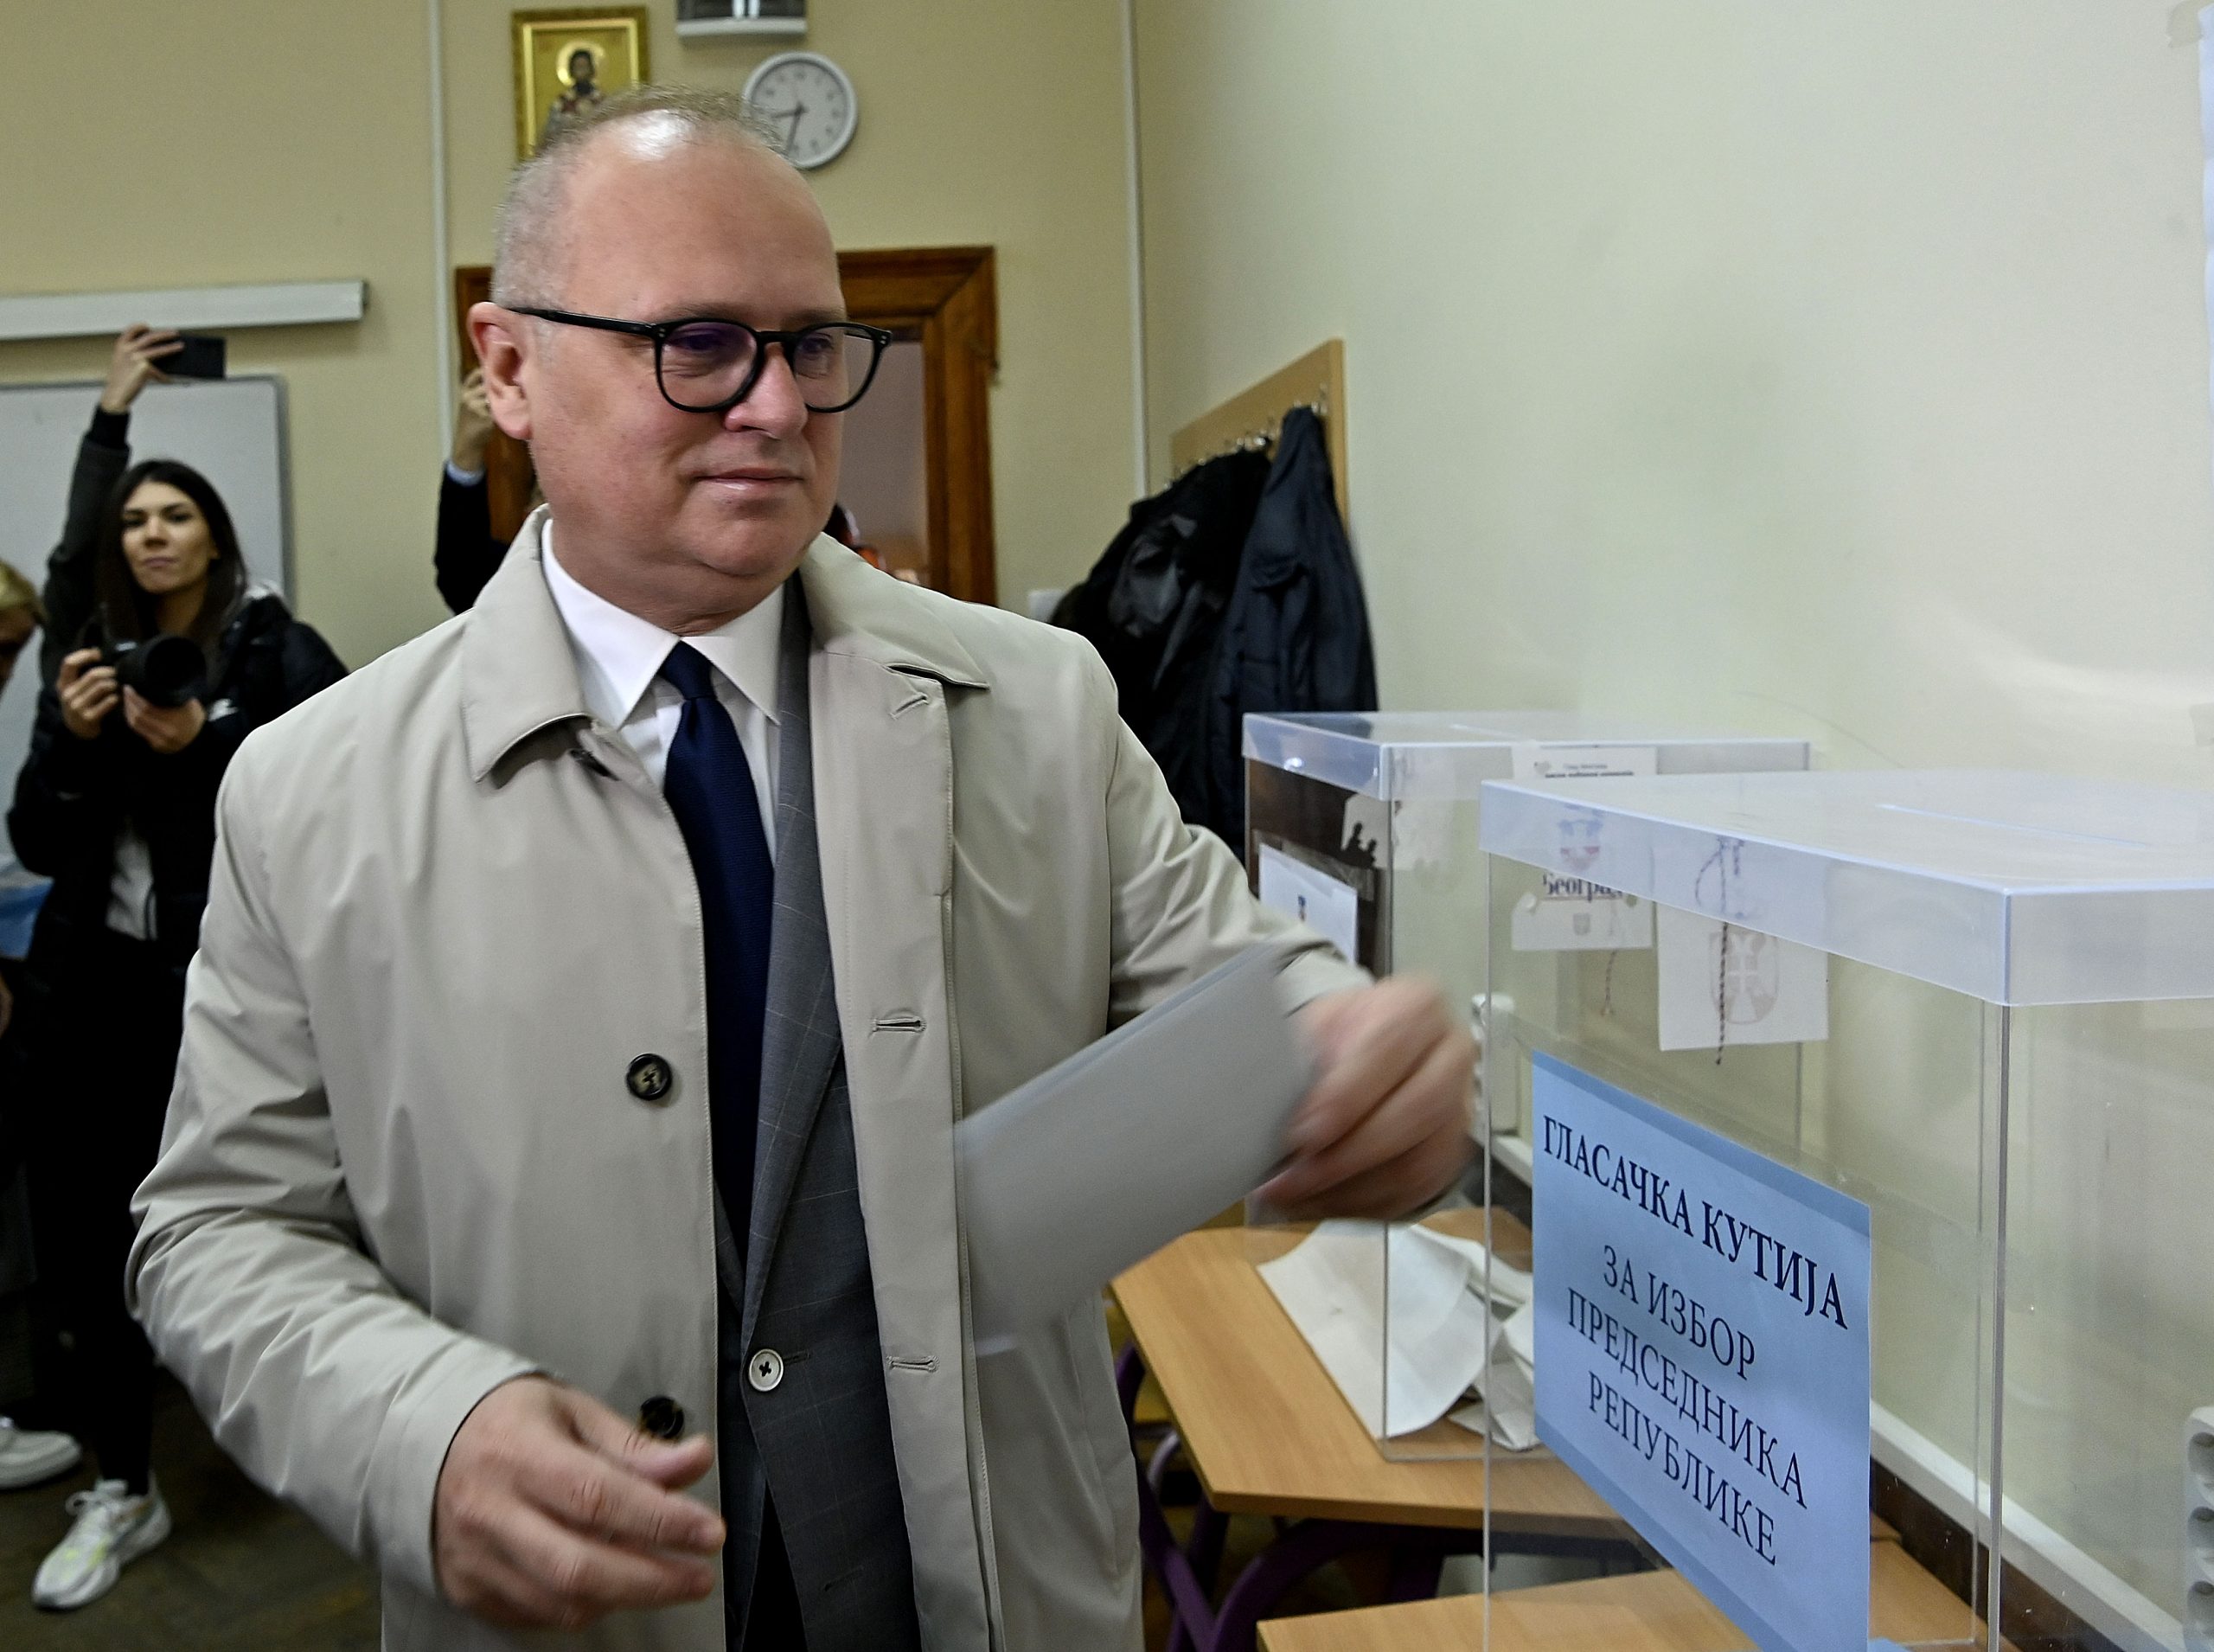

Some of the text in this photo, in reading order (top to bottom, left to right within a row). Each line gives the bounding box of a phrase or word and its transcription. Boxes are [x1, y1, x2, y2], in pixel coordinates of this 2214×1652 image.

[1543, 1114, 1849, 1331] ГЛАСАЧКА КУТИЈА
[1603, 1244, 1756, 1382] ЗА ИЗБОР
[1566, 1285, 1808, 1511] ПРЕДСЕДНИКА
[1588, 1370, 1777, 1567] РЕПУБЛИКЕ
